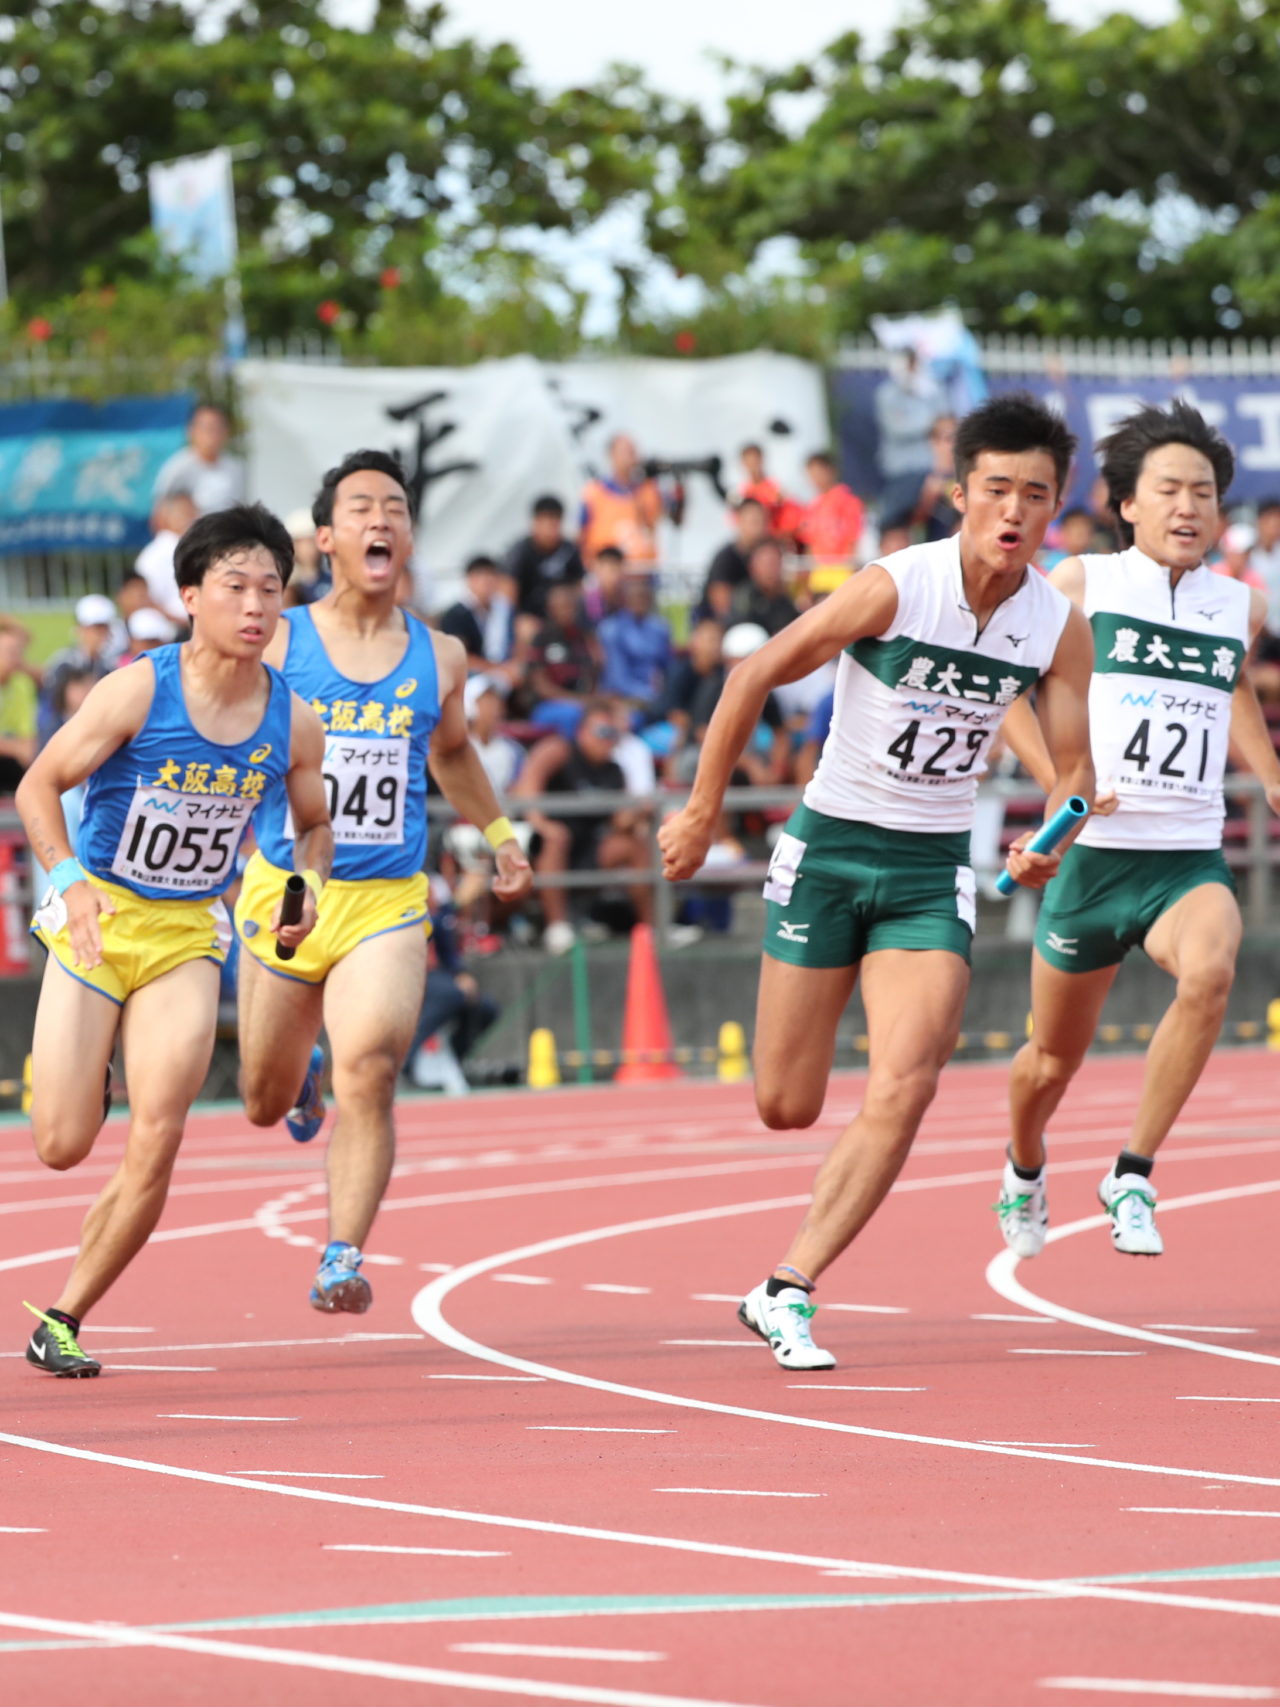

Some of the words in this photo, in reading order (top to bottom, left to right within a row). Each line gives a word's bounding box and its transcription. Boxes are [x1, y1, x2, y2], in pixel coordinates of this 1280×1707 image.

[1107, 628, 1236, 683] 農大二高
[899, 656, 1022, 706] 農大二高
[312, 698, 415, 738] 大阪高校
[1160, 694, 1217, 720] マイナビ
[341, 747, 399, 765] マイナビ
[887, 719, 990, 776] 429
[1123, 719, 1209, 783] 421
[152, 758, 267, 800] 大阪高校
[186, 802, 246, 819] マイナビ
[126, 814, 234, 874] 1055
